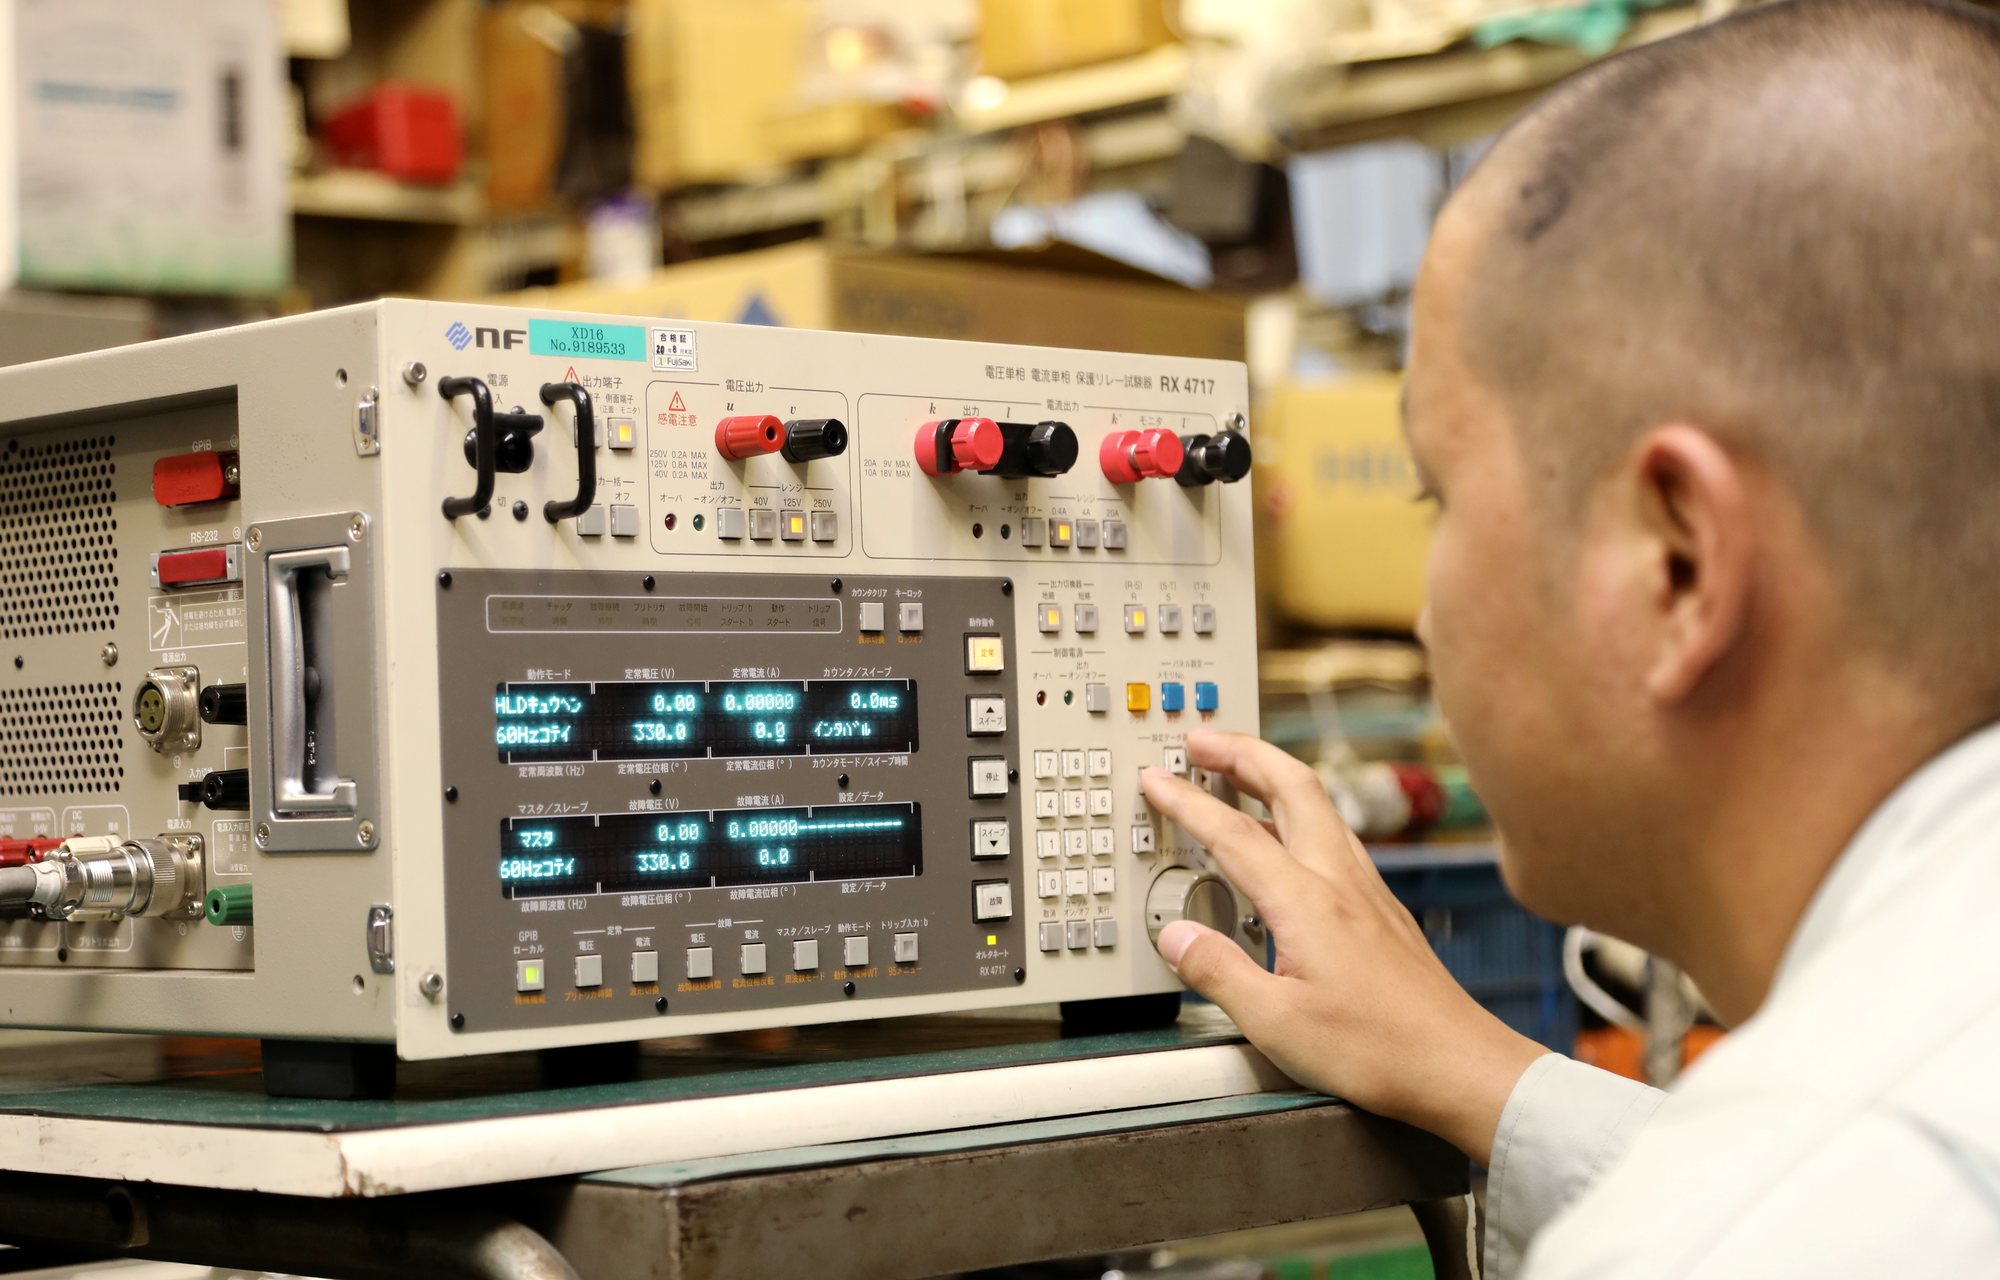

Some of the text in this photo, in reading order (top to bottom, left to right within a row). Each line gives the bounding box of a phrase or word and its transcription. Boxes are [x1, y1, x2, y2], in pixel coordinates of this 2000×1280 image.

[572, 327, 604, 341] XD16
[550, 339, 626, 355] No.9189533
[487, 373, 509, 387] 電源
[582, 376, 623, 390] 出力端子
[725, 379, 764, 393] 電圧出力
[985, 365, 1215, 395] 電圧単相 電流単相 保護リレー試験器 RX 4717
[494, 393, 503, 405] 入
[963, 405, 980, 417] 出力
[1046, 399, 1080, 412] 電流出力
[657, 413, 698, 427] 感電注意
[192, 439, 212, 453] GPIB
[650, 450, 707, 460] 250V 0.2A MAX
[650, 460, 708, 470] 125V 0.8A MAX
[863, 459, 911, 469] 20A 9V MAX
[654, 470, 708, 480] 40V 0.2A MAX
[864, 469, 911, 478] 10A 18V MAX
[709, 481, 725, 490] 出力
[615, 492, 630, 502] オフ
[753, 497, 768, 506] 40V
[783, 498, 802, 507] 125V
[813, 499, 832, 508] 250V
[190, 530, 219, 544] RS-232
[851, 588, 923, 598] カウンタクリア キーロック
[527, 666, 893, 681] 動作モード 定常電圧(V) 定常電流(A) カウンタ/スイープ
[654, 694, 696, 712] 0.00
[725, 693, 795, 711] 0.00000
[851, 692, 899, 710] 0.0ms
[633, 723, 687, 741] 330.0
[755, 721, 786, 739] 0.0
[1047, 758, 1053, 770] 7
[1073, 758, 1080, 770] 8
[1100, 756, 1106, 768] 9
[518, 765, 585, 778] 定常周波数(Hz)
[628, 798, 680, 812] 故障電圧(V)
[736, 793, 785, 807] 故障電流(A)
[838, 791, 885, 804] 設定/データ
[1047, 799, 1053, 811] 4
[1075, 796, 1081, 809] 5
[1100, 796, 1107, 808] 6
[72, 810, 83, 821] DC
[520, 819, 798, 848] マスタ 0.00 0.00000
[1076, 837, 1082, 849] 2
[1102, 836, 1109, 848] 3
[637, 852, 690, 872] 330.0
[759, 848, 789, 866] 0.0
[841, 881, 888, 894] 設定/データ
[1050, 878, 1056, 890] 0
[717, 918, 733, 929] 故障
[837, 921, 872, 933] 動作モード
[518, 930, 539, 943] GPIB
[606, 925, 623, 936] 定常
[744, 929, 760, 940] 電流
[635, 937, 652, 948] 電流
[690, 933, 706, 944] 電圧
[513, 944, 545, 955] ローカル
[578, 940, 595, 951] 電圧
[980, 965, 1007, 977] RX 4717
